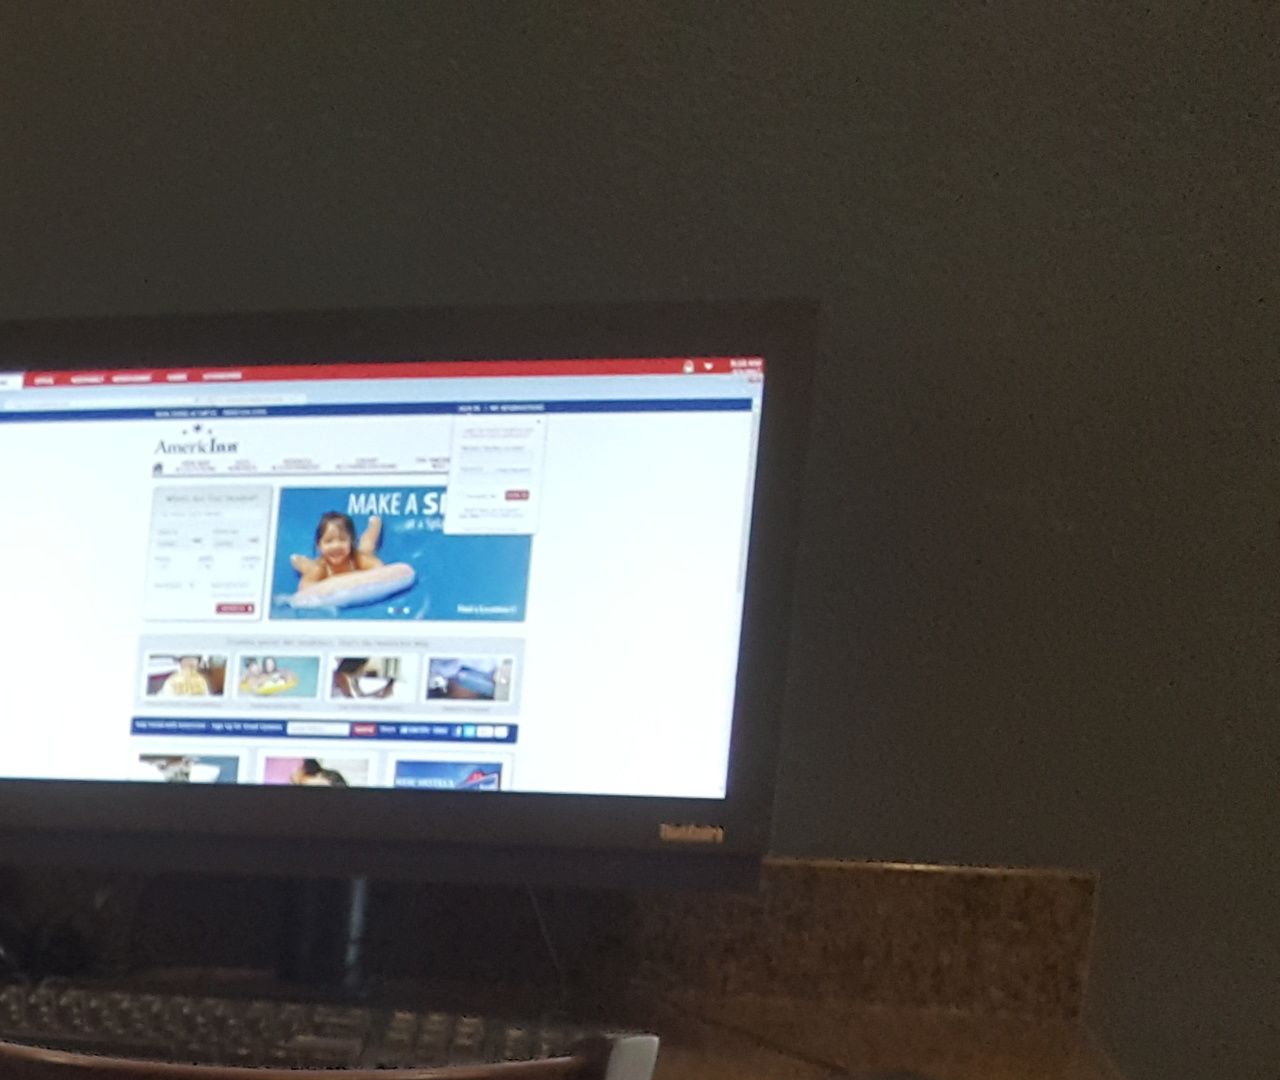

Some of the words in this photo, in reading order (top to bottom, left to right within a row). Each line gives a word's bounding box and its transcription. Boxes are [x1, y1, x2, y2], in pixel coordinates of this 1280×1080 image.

[154, 437, 239, 455] AmericInn
[347, 491, 402, 516] MAKE
[404, 491, 419, 516] A
